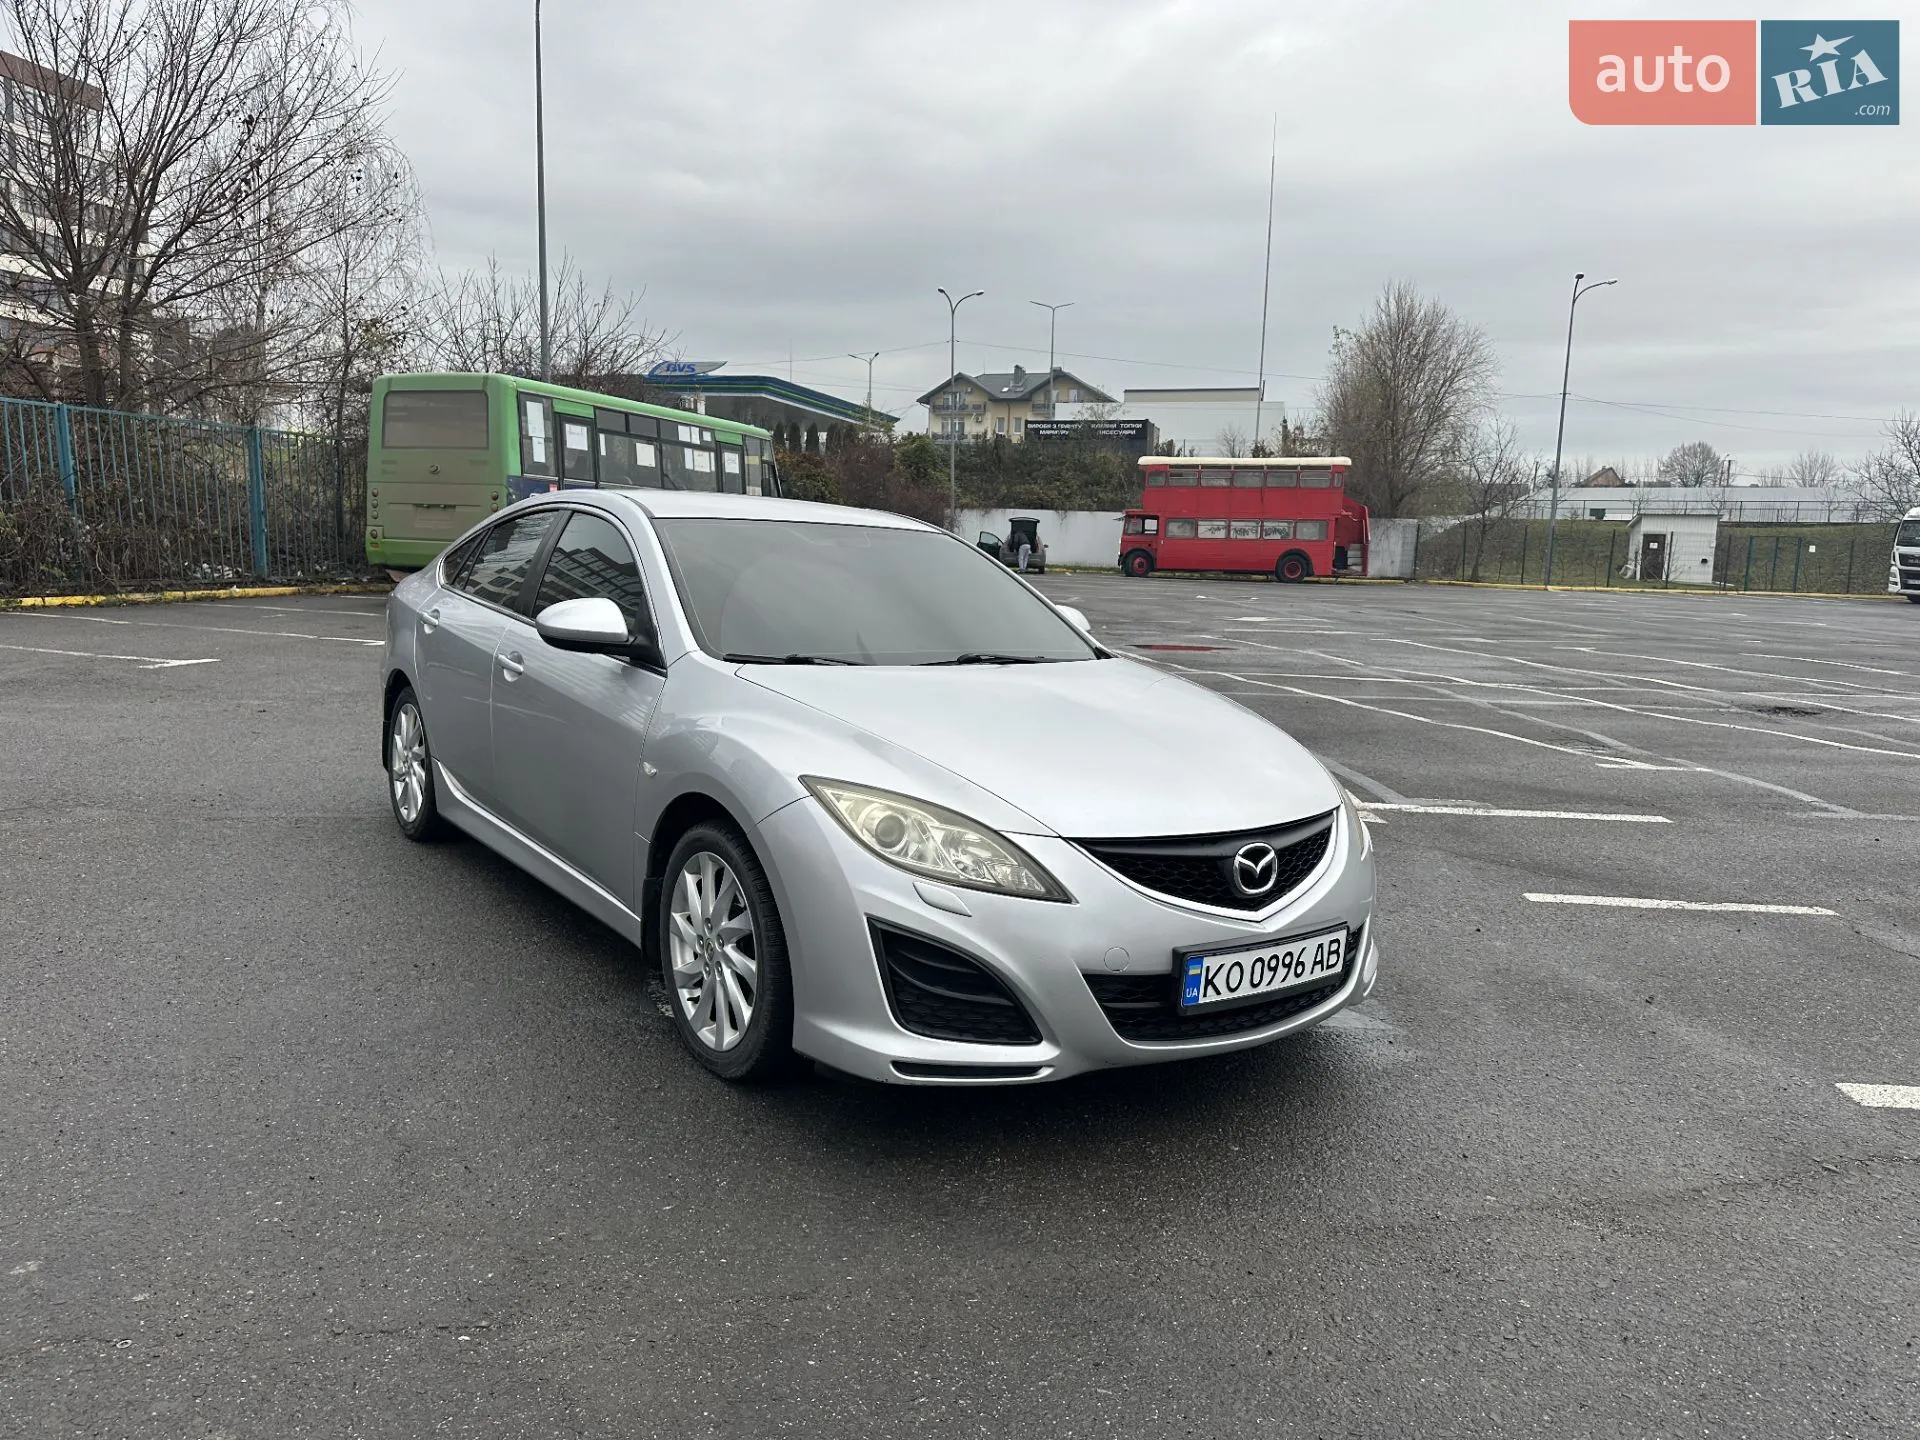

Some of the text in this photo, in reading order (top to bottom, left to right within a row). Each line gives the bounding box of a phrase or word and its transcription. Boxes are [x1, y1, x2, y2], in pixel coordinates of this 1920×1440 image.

[1202, 938, 1341, 998] KO 0996 AB
[1186, 988, 1198, 998] UA
